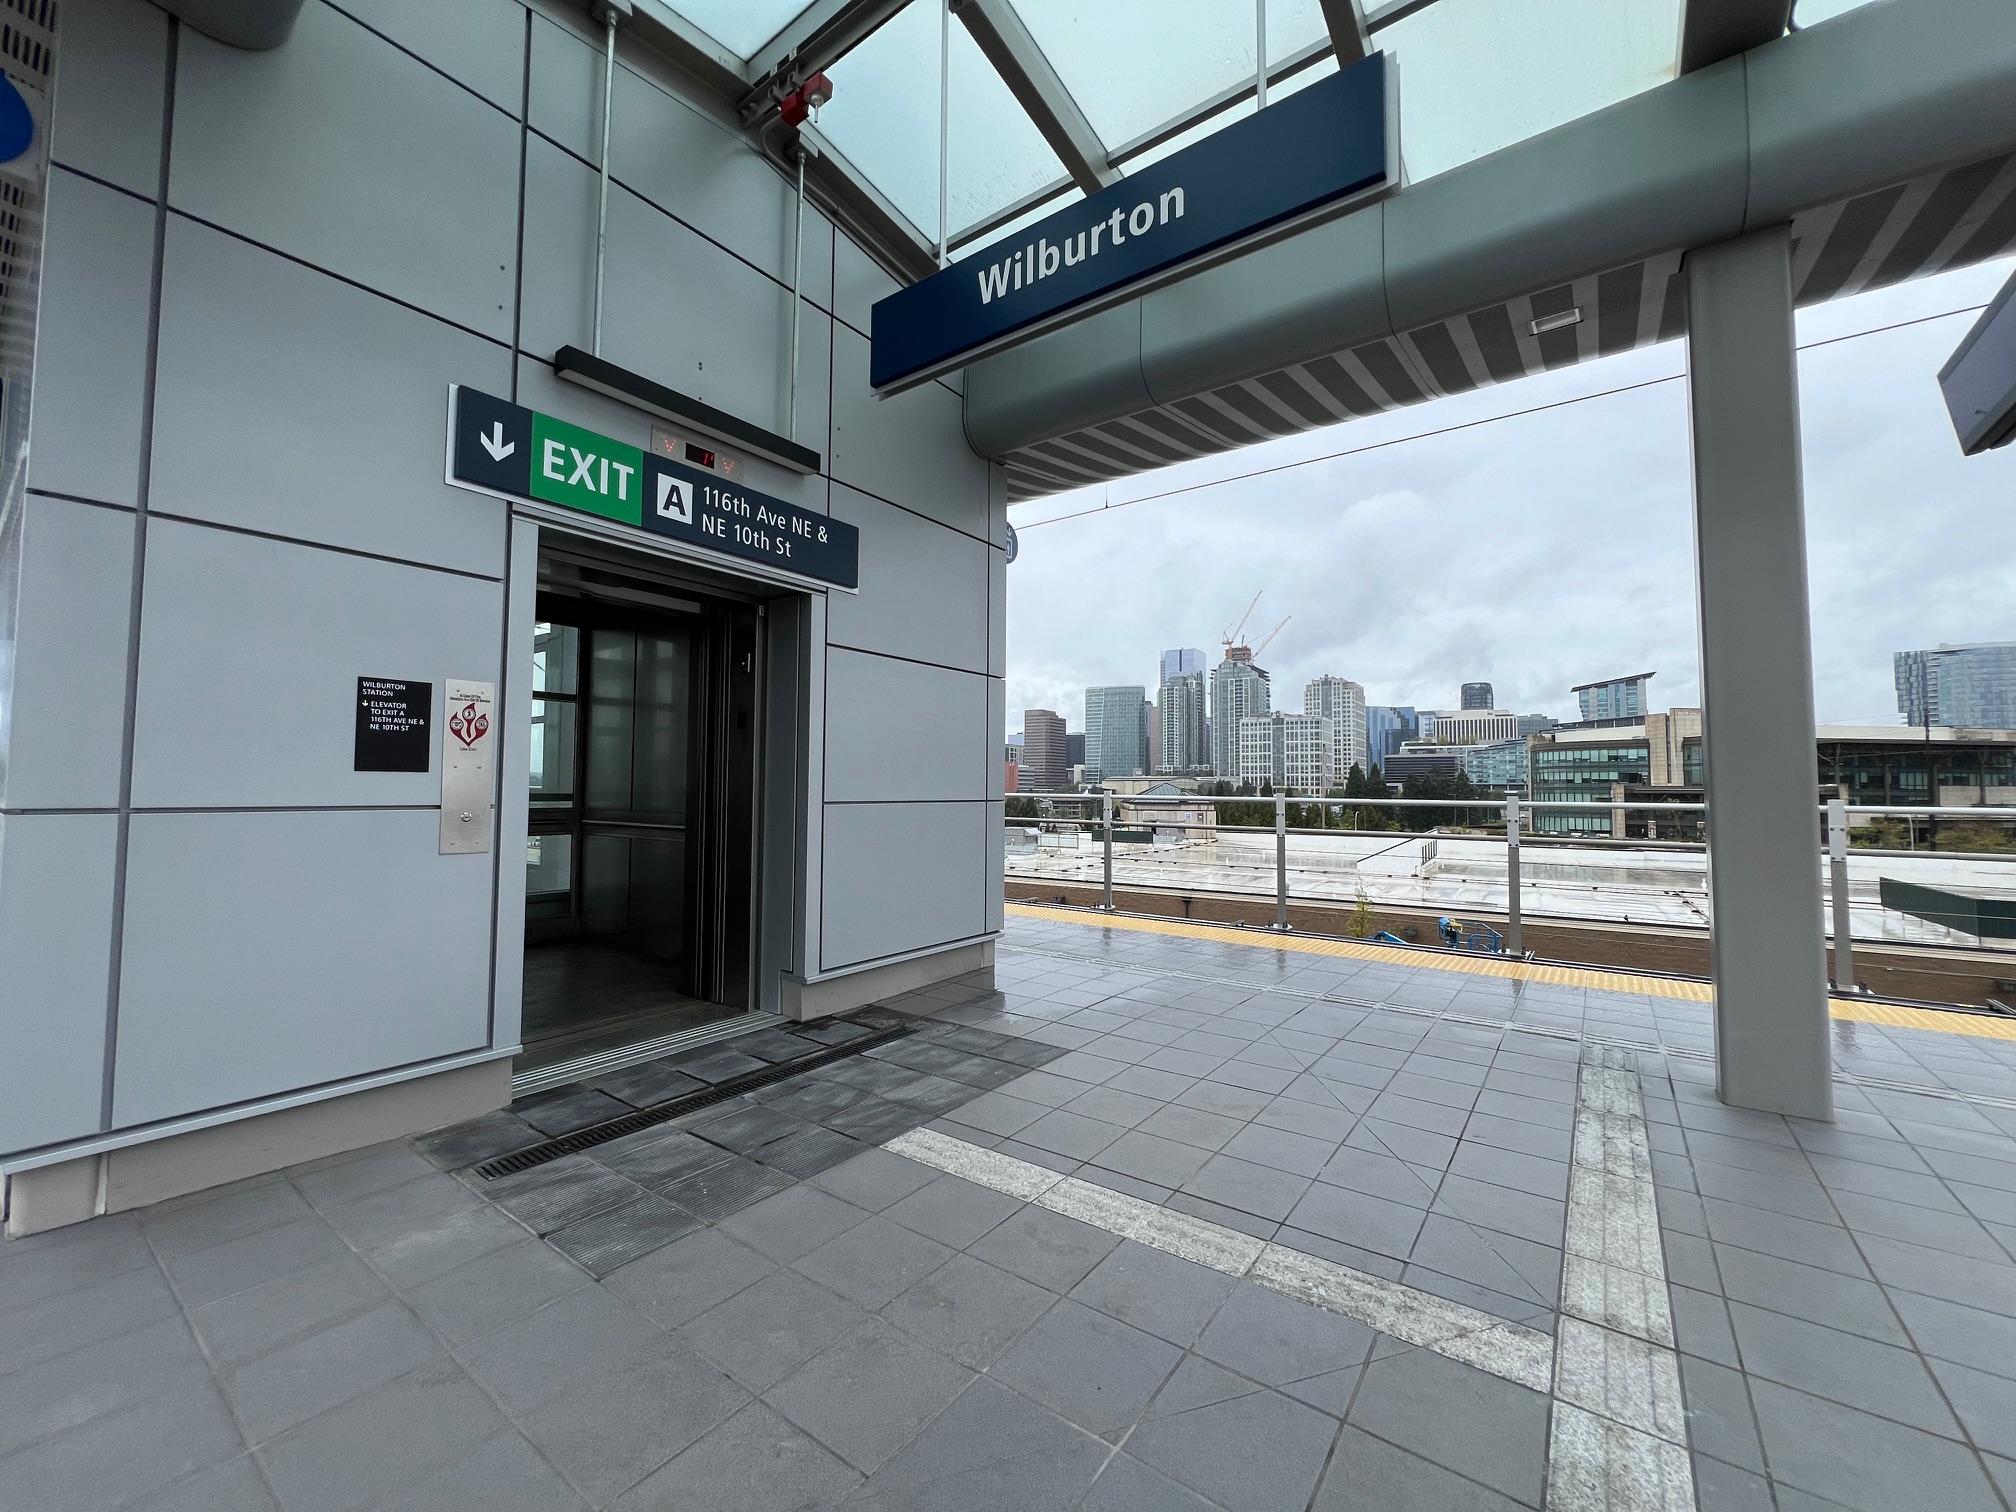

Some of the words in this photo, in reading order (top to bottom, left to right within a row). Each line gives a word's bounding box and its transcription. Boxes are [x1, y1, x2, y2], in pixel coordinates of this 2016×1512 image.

[978, 186, 1185, 305] Wilburton
[543, 438, 635, 501] EXIT
[663, 483, 687, 517] A
[703, 486, 750, 518] 116th
[756, 505, 786, 530] Ave
[792, 515, 812, 539] NE
[817, 525, 828, 544] &
[702, 513, 726, 538] NE
[734, 524, 770, 551] 10th
[776, 537, 792, 558] St
[362, 681, 406, 690] WILBURTON
[362, 688, 394, 697] STATION
[371, 700, 407, 709] ELEVATOR
